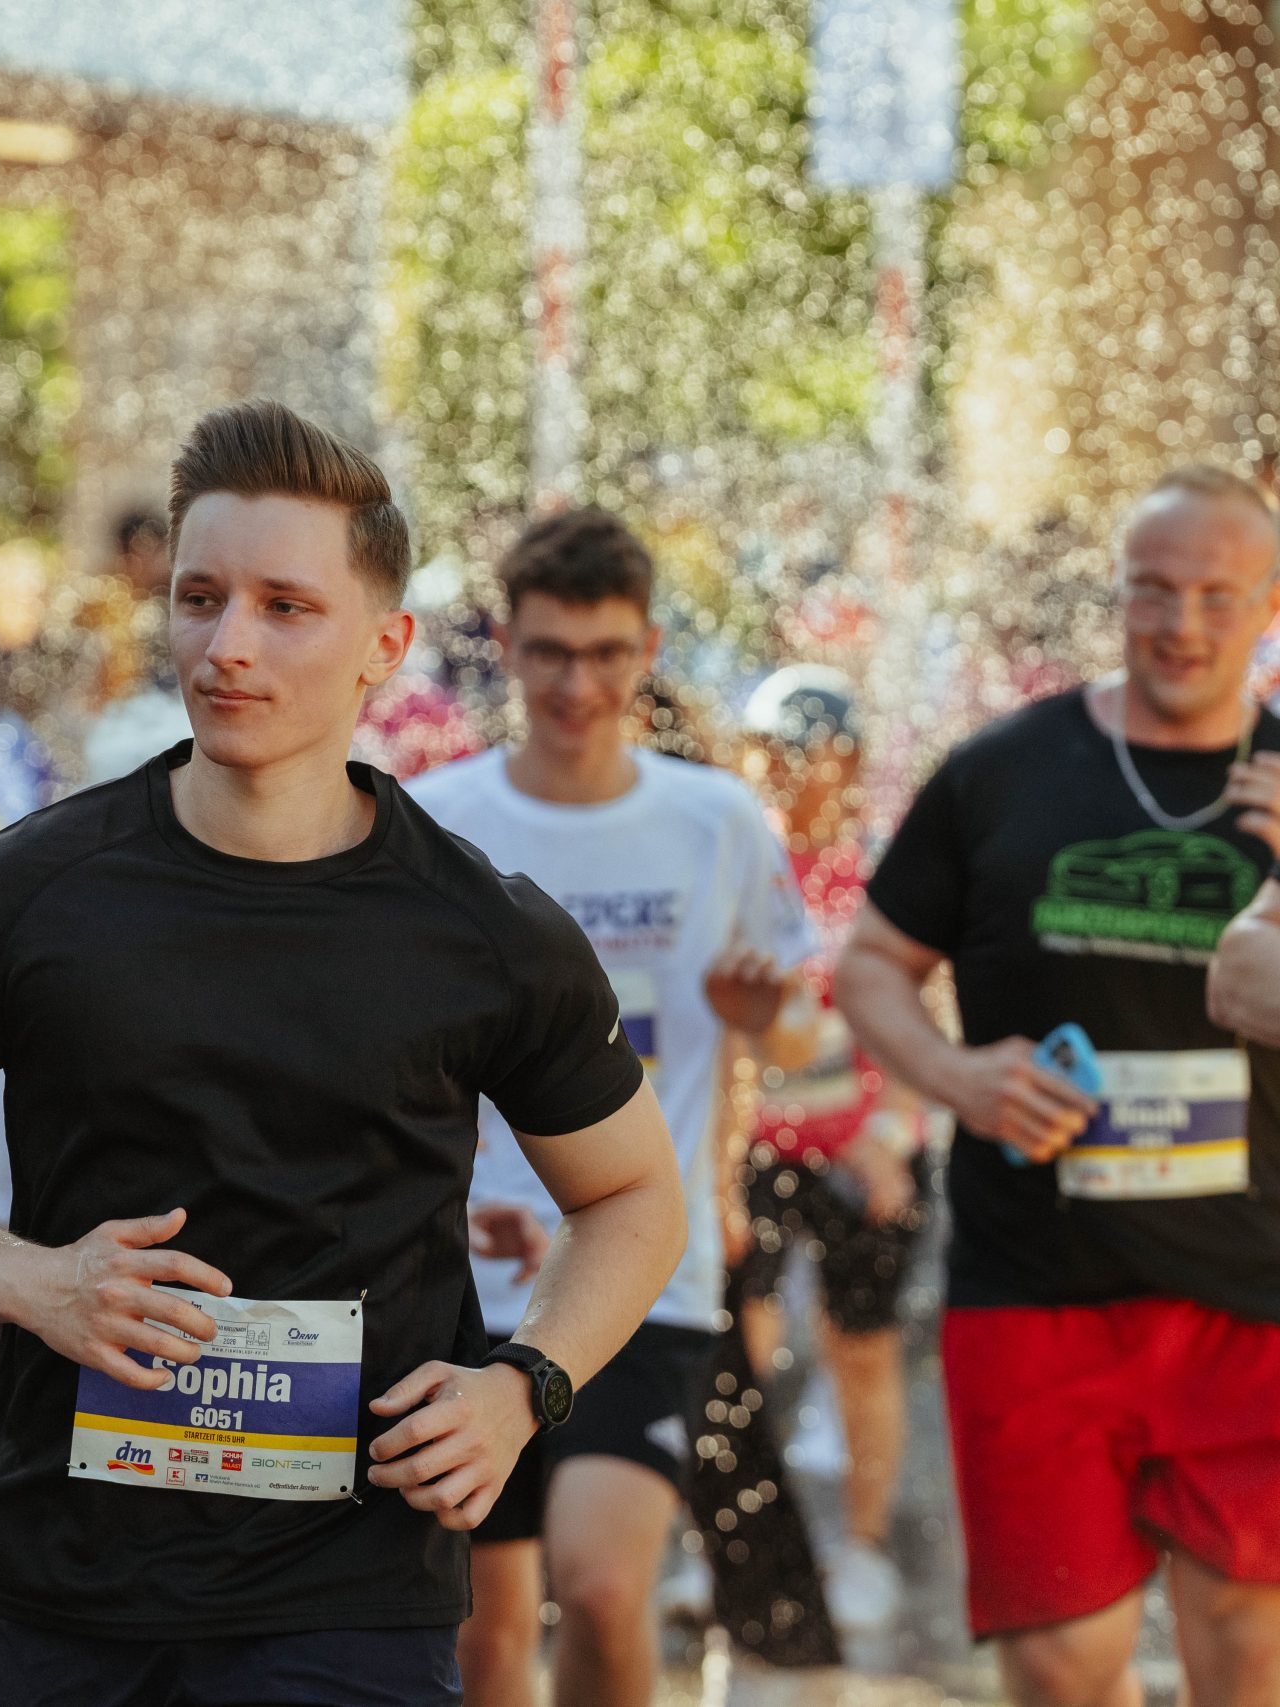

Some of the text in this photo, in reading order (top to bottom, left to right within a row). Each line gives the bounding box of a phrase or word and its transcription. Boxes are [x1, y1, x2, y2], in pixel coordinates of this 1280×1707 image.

[152, 1355, 292, 1405] Sophia
[190, 1406, 243, 1430] 6051
[184, 1430, 216, 1440] STARTZEIT
[232, 1436, 245, 1444] UHR
[116, 1441, 151, 1464] dm
[184, 1455, 209, 1464] 88.3
[222, 1451, 242, 1459] SCHUH
[252, 1458, 322, 1470] BIONTECH
